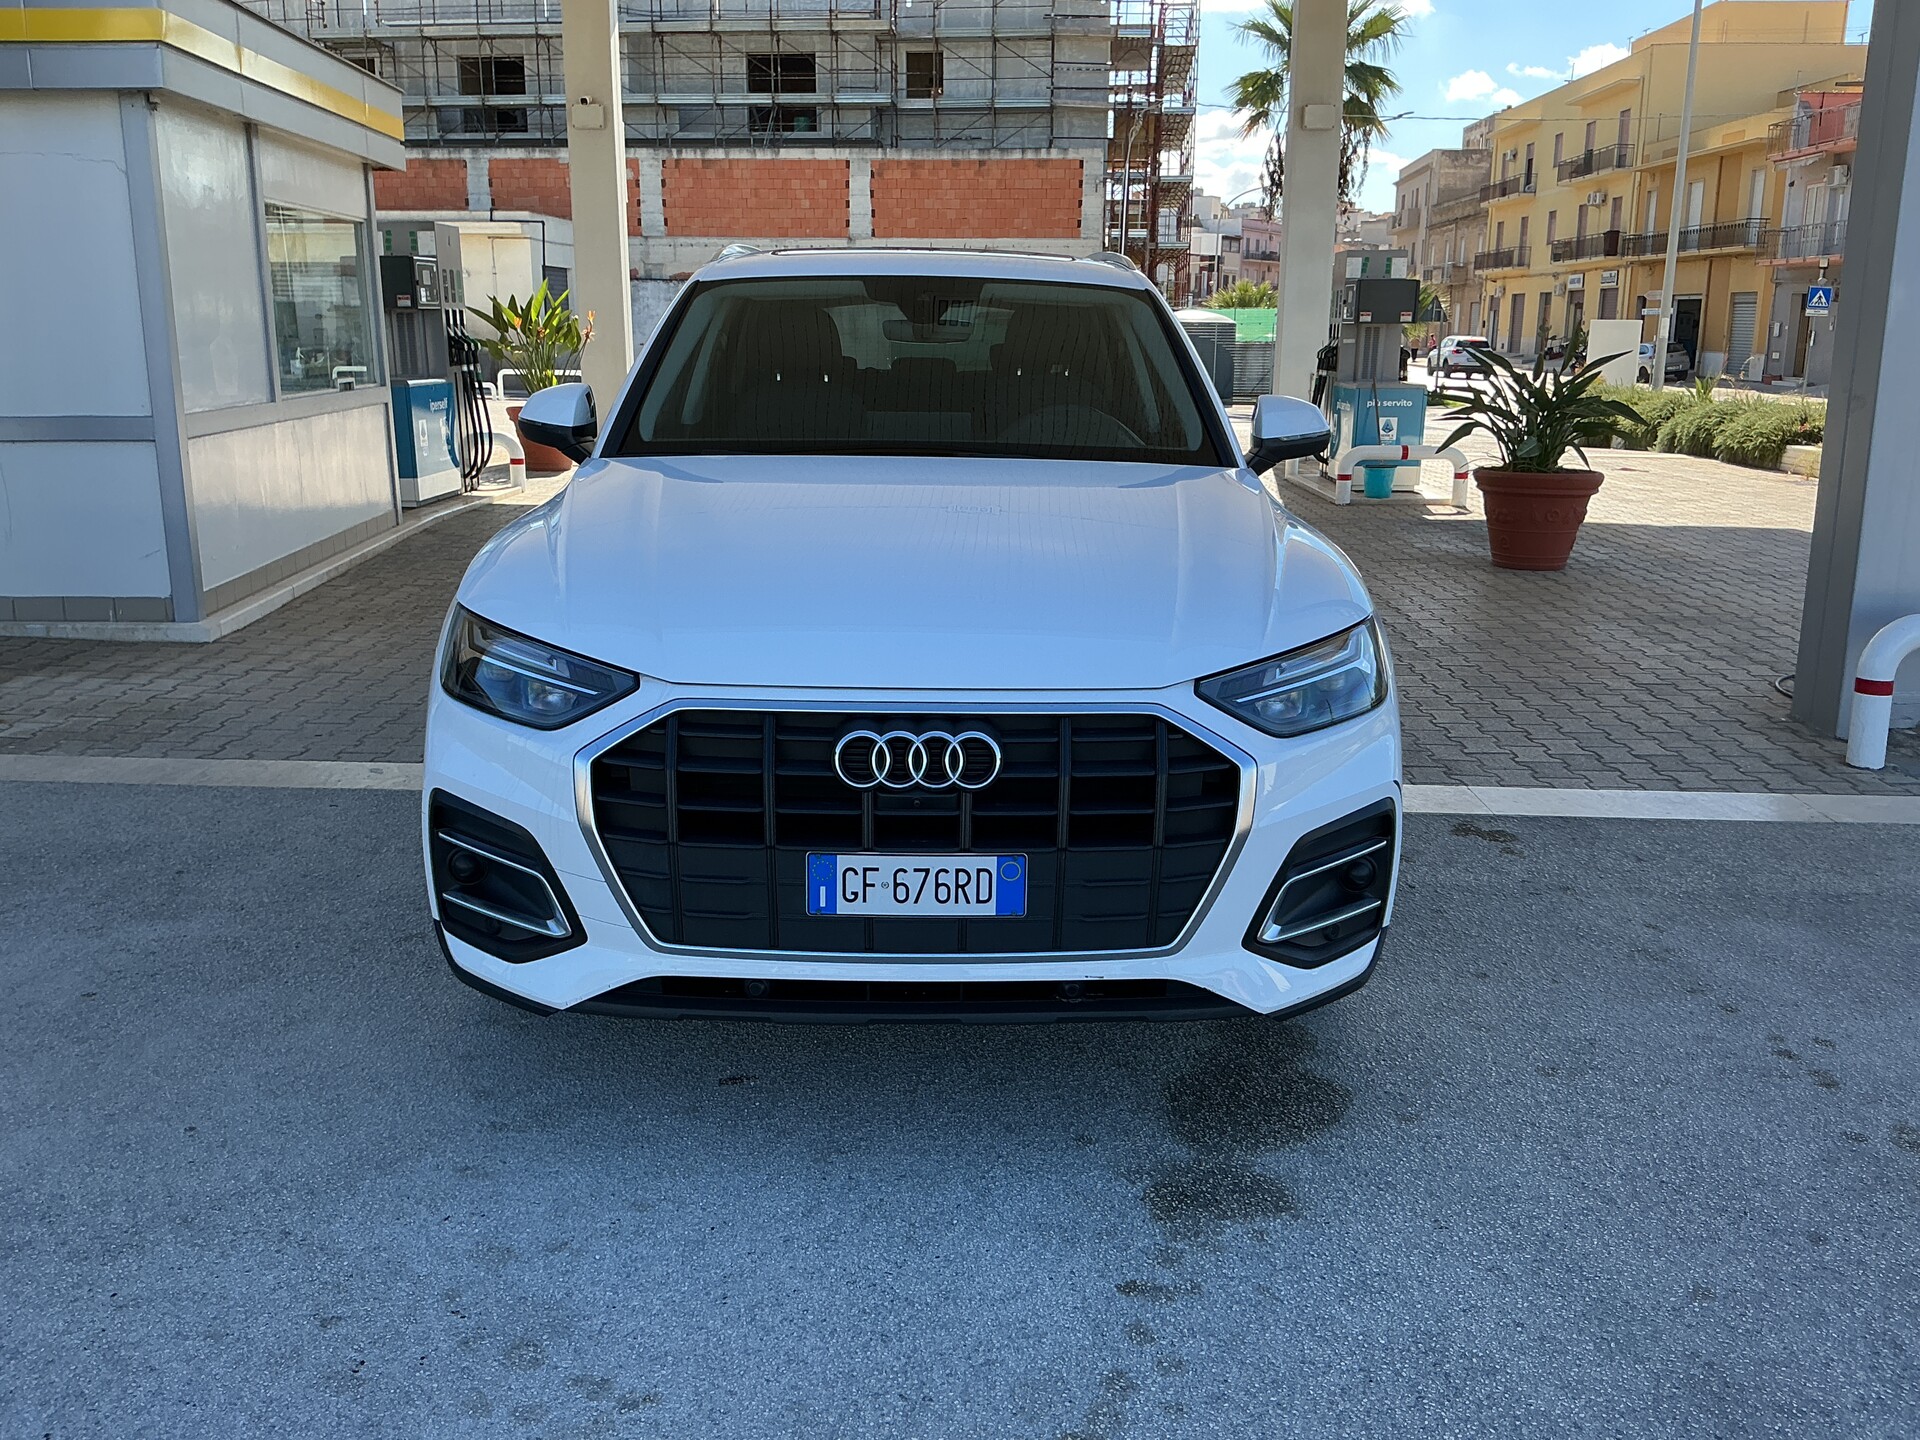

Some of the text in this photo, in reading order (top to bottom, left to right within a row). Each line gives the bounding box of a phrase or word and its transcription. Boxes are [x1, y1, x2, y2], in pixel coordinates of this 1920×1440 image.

[1383, 399, 1412, 407] servito
[841, 866, 993, 905] GF 676RD
